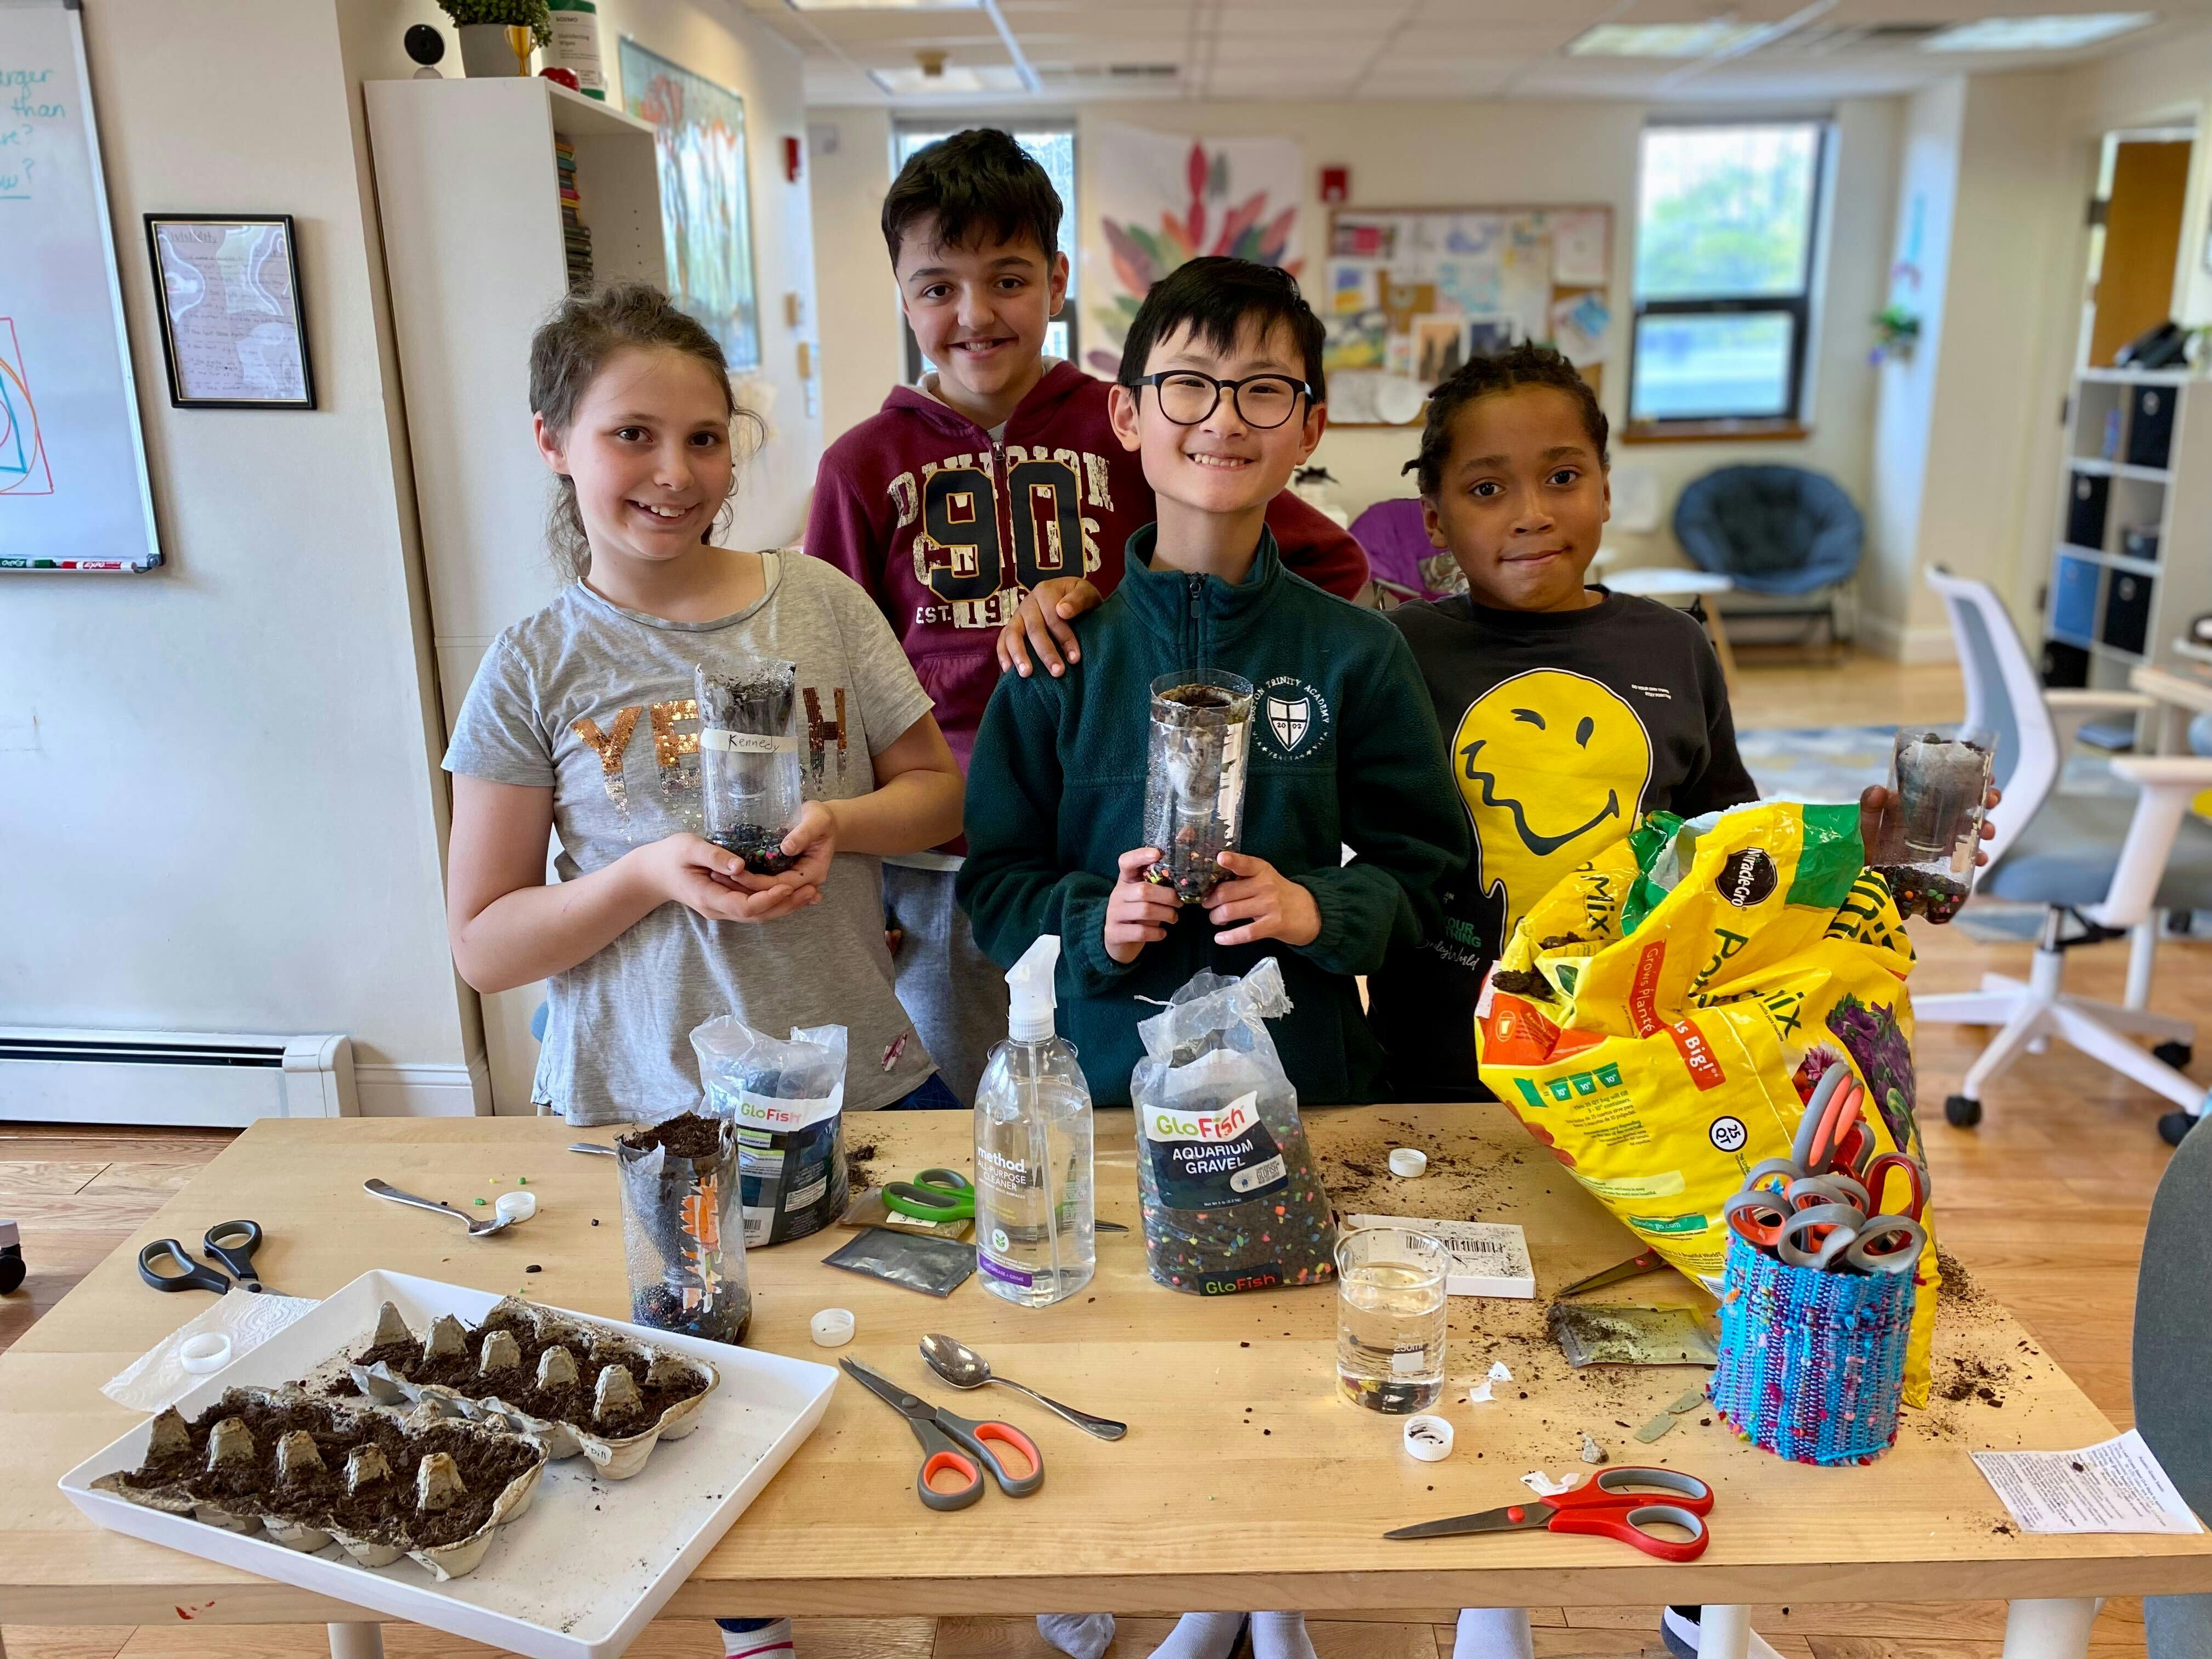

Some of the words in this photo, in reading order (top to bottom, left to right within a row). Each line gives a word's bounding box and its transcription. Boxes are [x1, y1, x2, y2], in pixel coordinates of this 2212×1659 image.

[11, 97, 65, 117] than
[923, 460, 1087, 603] 90
[916, 605, 951, 624] EST.
[952, 586, 1024, 629] 19
[1265, 676, 1302, 689] TRINITY
[1304, 684, 1330, 724] ACADEMY
[571, 687, 848, 774] YEH
[728, 734, 780, 753] Kennedy
[1580, 875, 1615, 934] Mix
[1639, 947, 1658, 987] Grows
[1685, 1035, 1714, 1072] Big!
[741, 1102, 802, 1124] GloFish
[1156, 1106, 1245, 1139] GloFish
[1716, 1127, 1732, 1144] QT
[1726, 1124, 1741, 1139] 25
[1172, 1138, 1254, 1161] AQUARIUM
[978, 1159, 1026, 1184] ALL-PURPOSE
[1185, 1155, 1246, 1175] GRAVEL
[983, 1171, 1017, 1192] CLEANER
[1205, 1273, 1276, 1294] GloFish
[1394, 1340, 1423, 1352] 250ml
[591, 1448, 606, 1460] Dill
